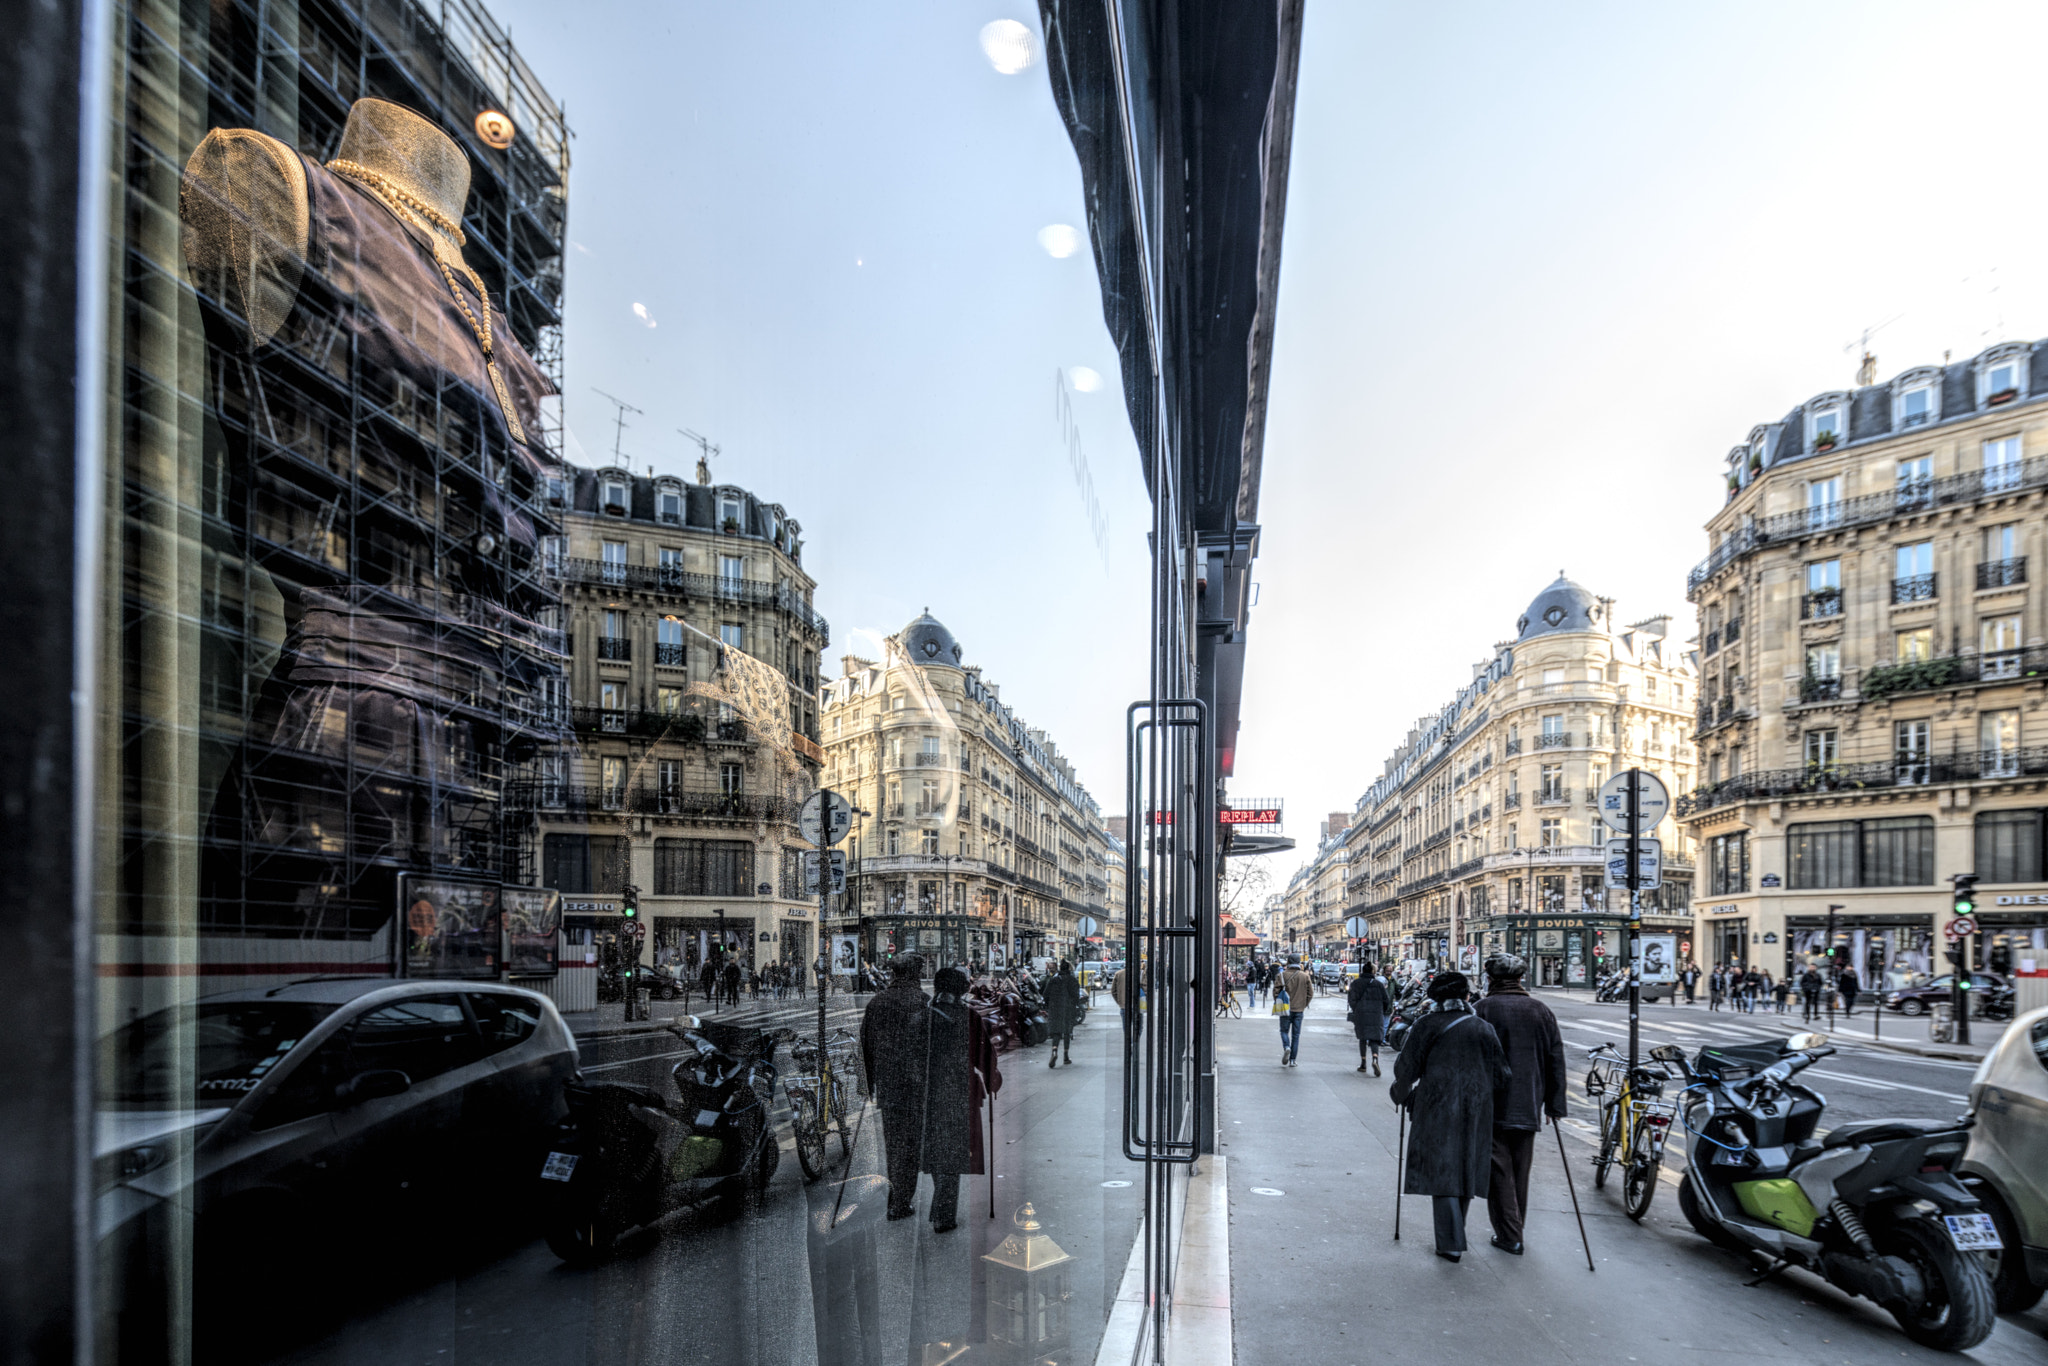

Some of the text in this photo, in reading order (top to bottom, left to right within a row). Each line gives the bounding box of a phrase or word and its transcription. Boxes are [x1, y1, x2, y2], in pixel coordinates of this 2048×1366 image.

[1056, 367, 1110, 579] momoni
[1220, 810, 1277, 823] REPLAY
[1711, 904, 1739, 914] DIESEL
[1516, 919, 1584, 928] LA BOVIDA
